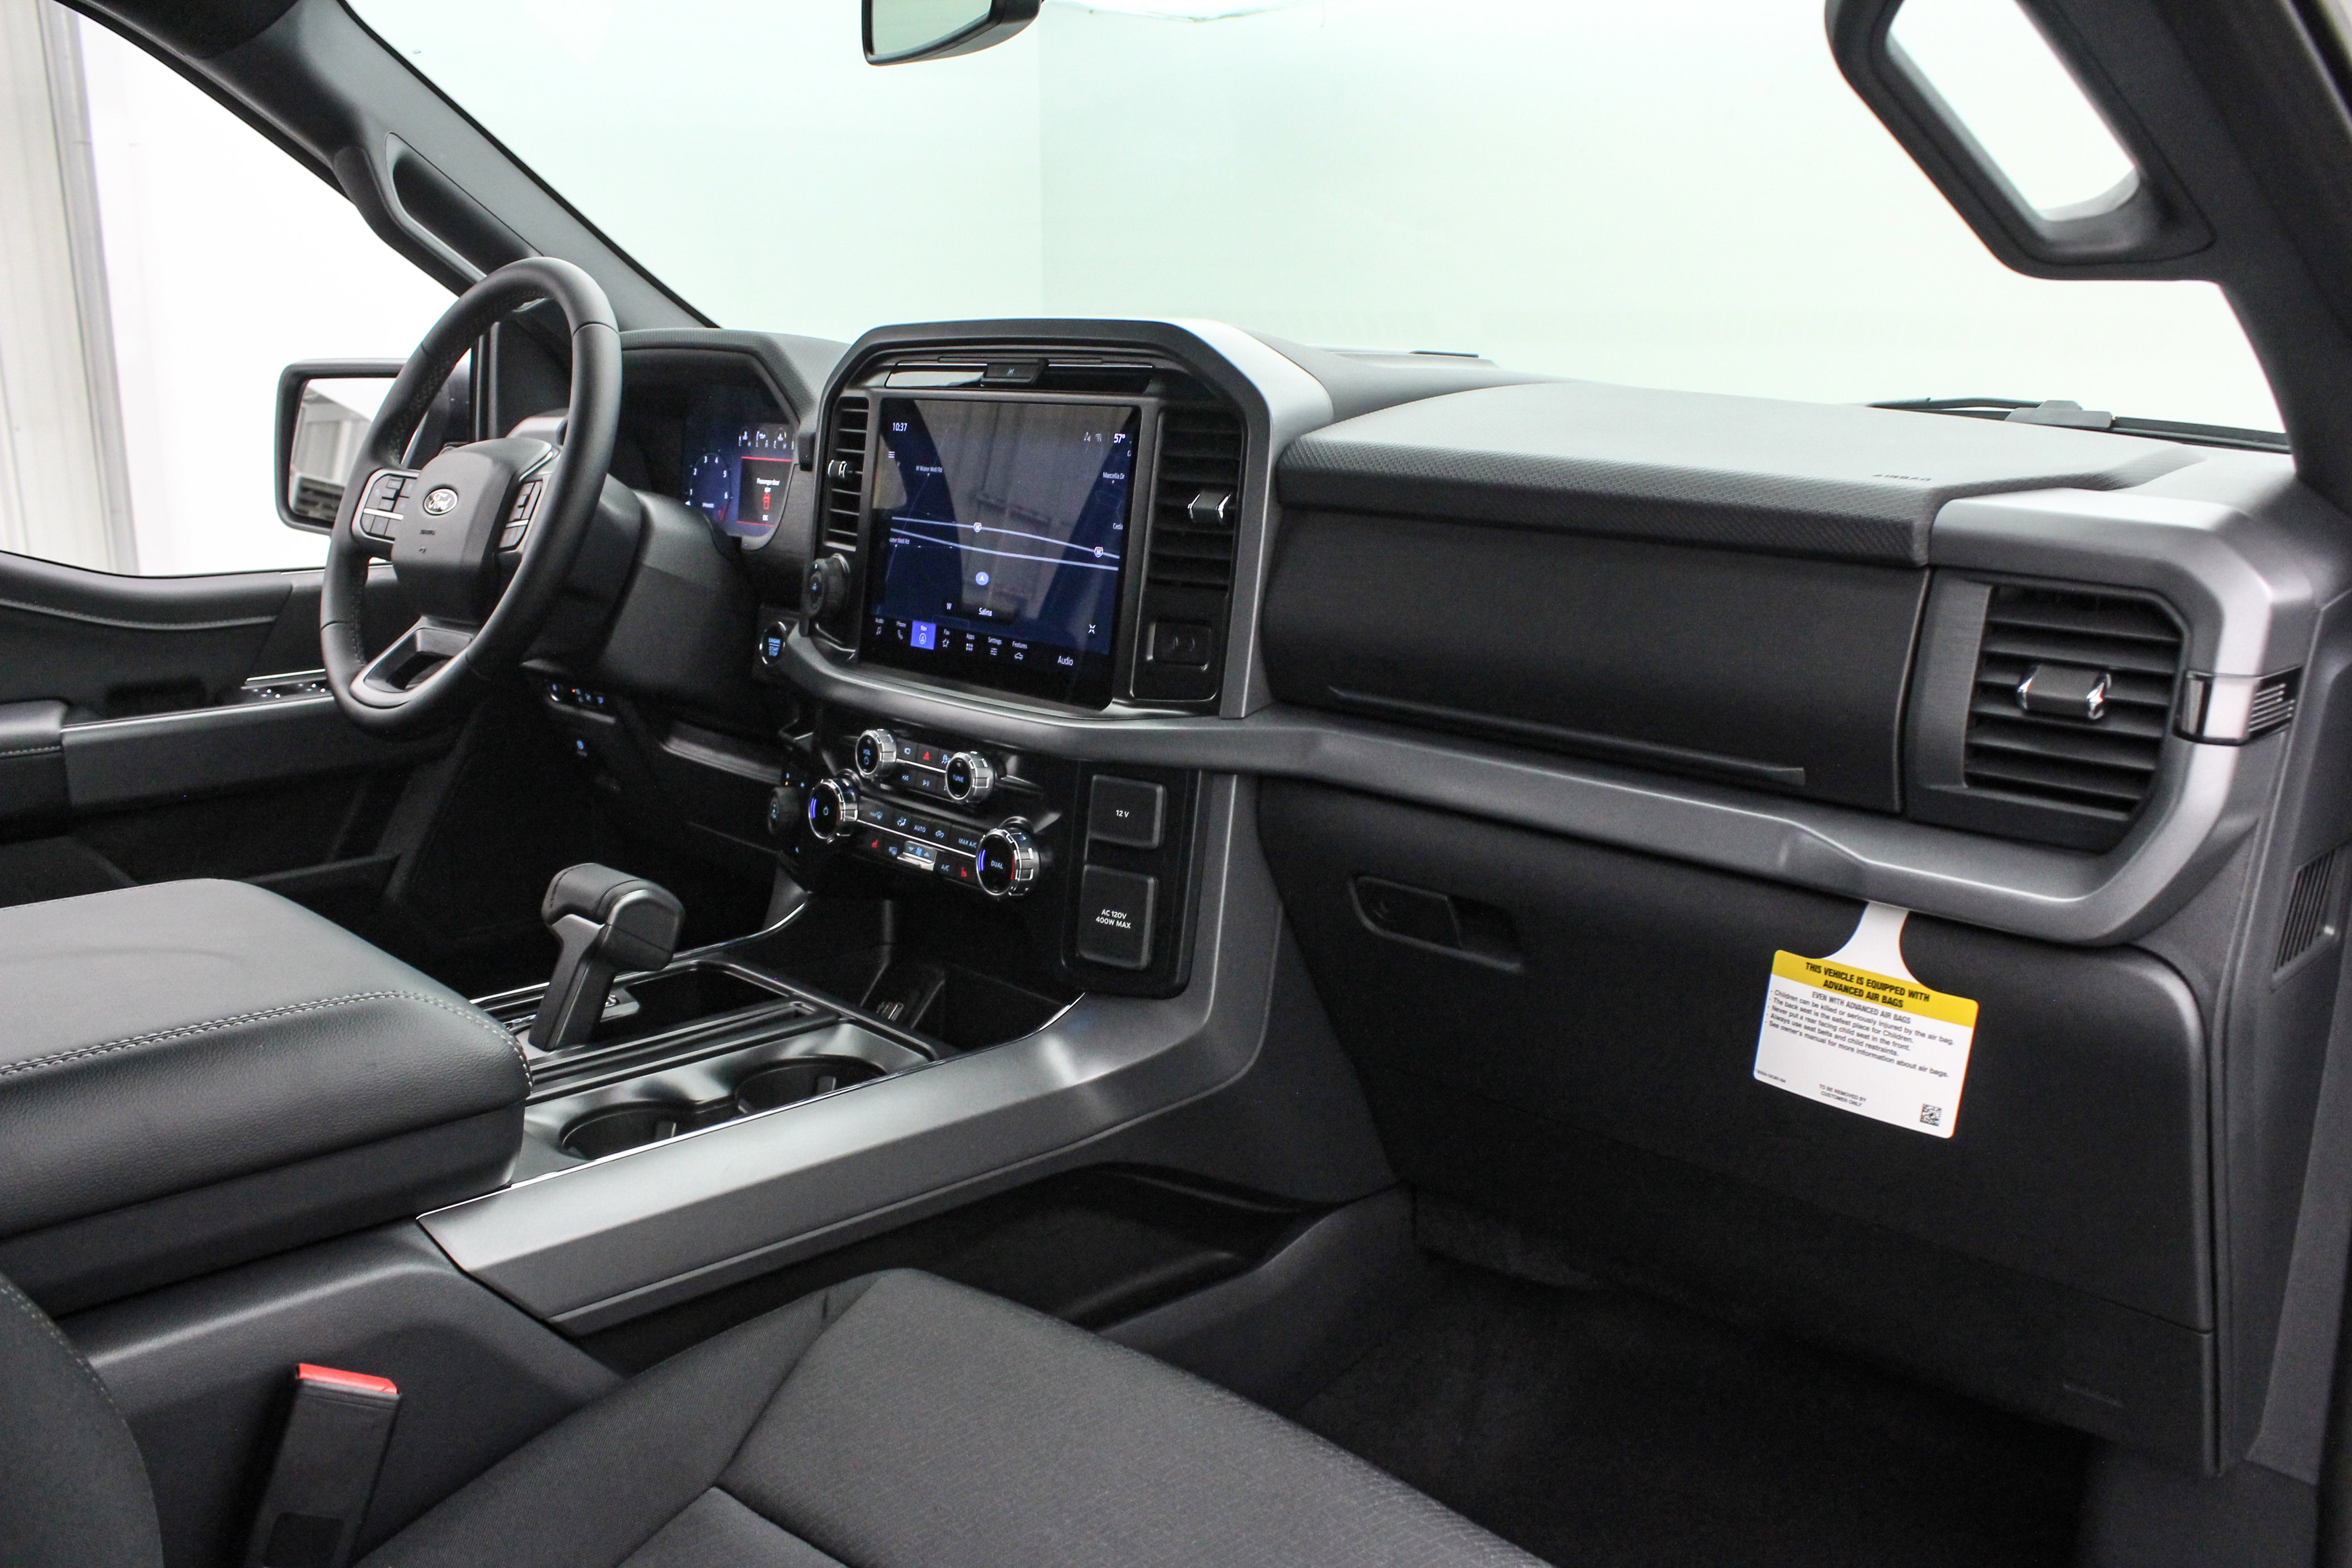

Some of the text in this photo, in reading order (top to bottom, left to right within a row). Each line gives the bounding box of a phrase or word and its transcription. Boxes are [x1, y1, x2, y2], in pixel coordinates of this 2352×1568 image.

[893, 422, 907, 431] 10:37
[428, 492, 451, 510] Ford
[979, 608, 992, 616] Salina
[988, 637, 1002, 646] Settings
[1012, 641, 1027, 649] Features
[1058, 656, 1073, 666] Audio
[953, 774, 964, 783] TUNE
[914, 825, 926, 833] AUTO
[959, 838, 977, 848] MAX A/C
[991, 860, 1003, 869] DUAL
[1111, 911, 1127, 919] 120V
[1096, 916, 1131, 929] 400W MAX
[1806, 962, 1930, 1002] THIS VEHICLE IS EQUIPPED WITH
[1823, 980, 1903, 1008] ADVANCED AIR BAGS
[1812, 991, 1911, 1024] EVEN WITH ADVANCED AIR BAGS
